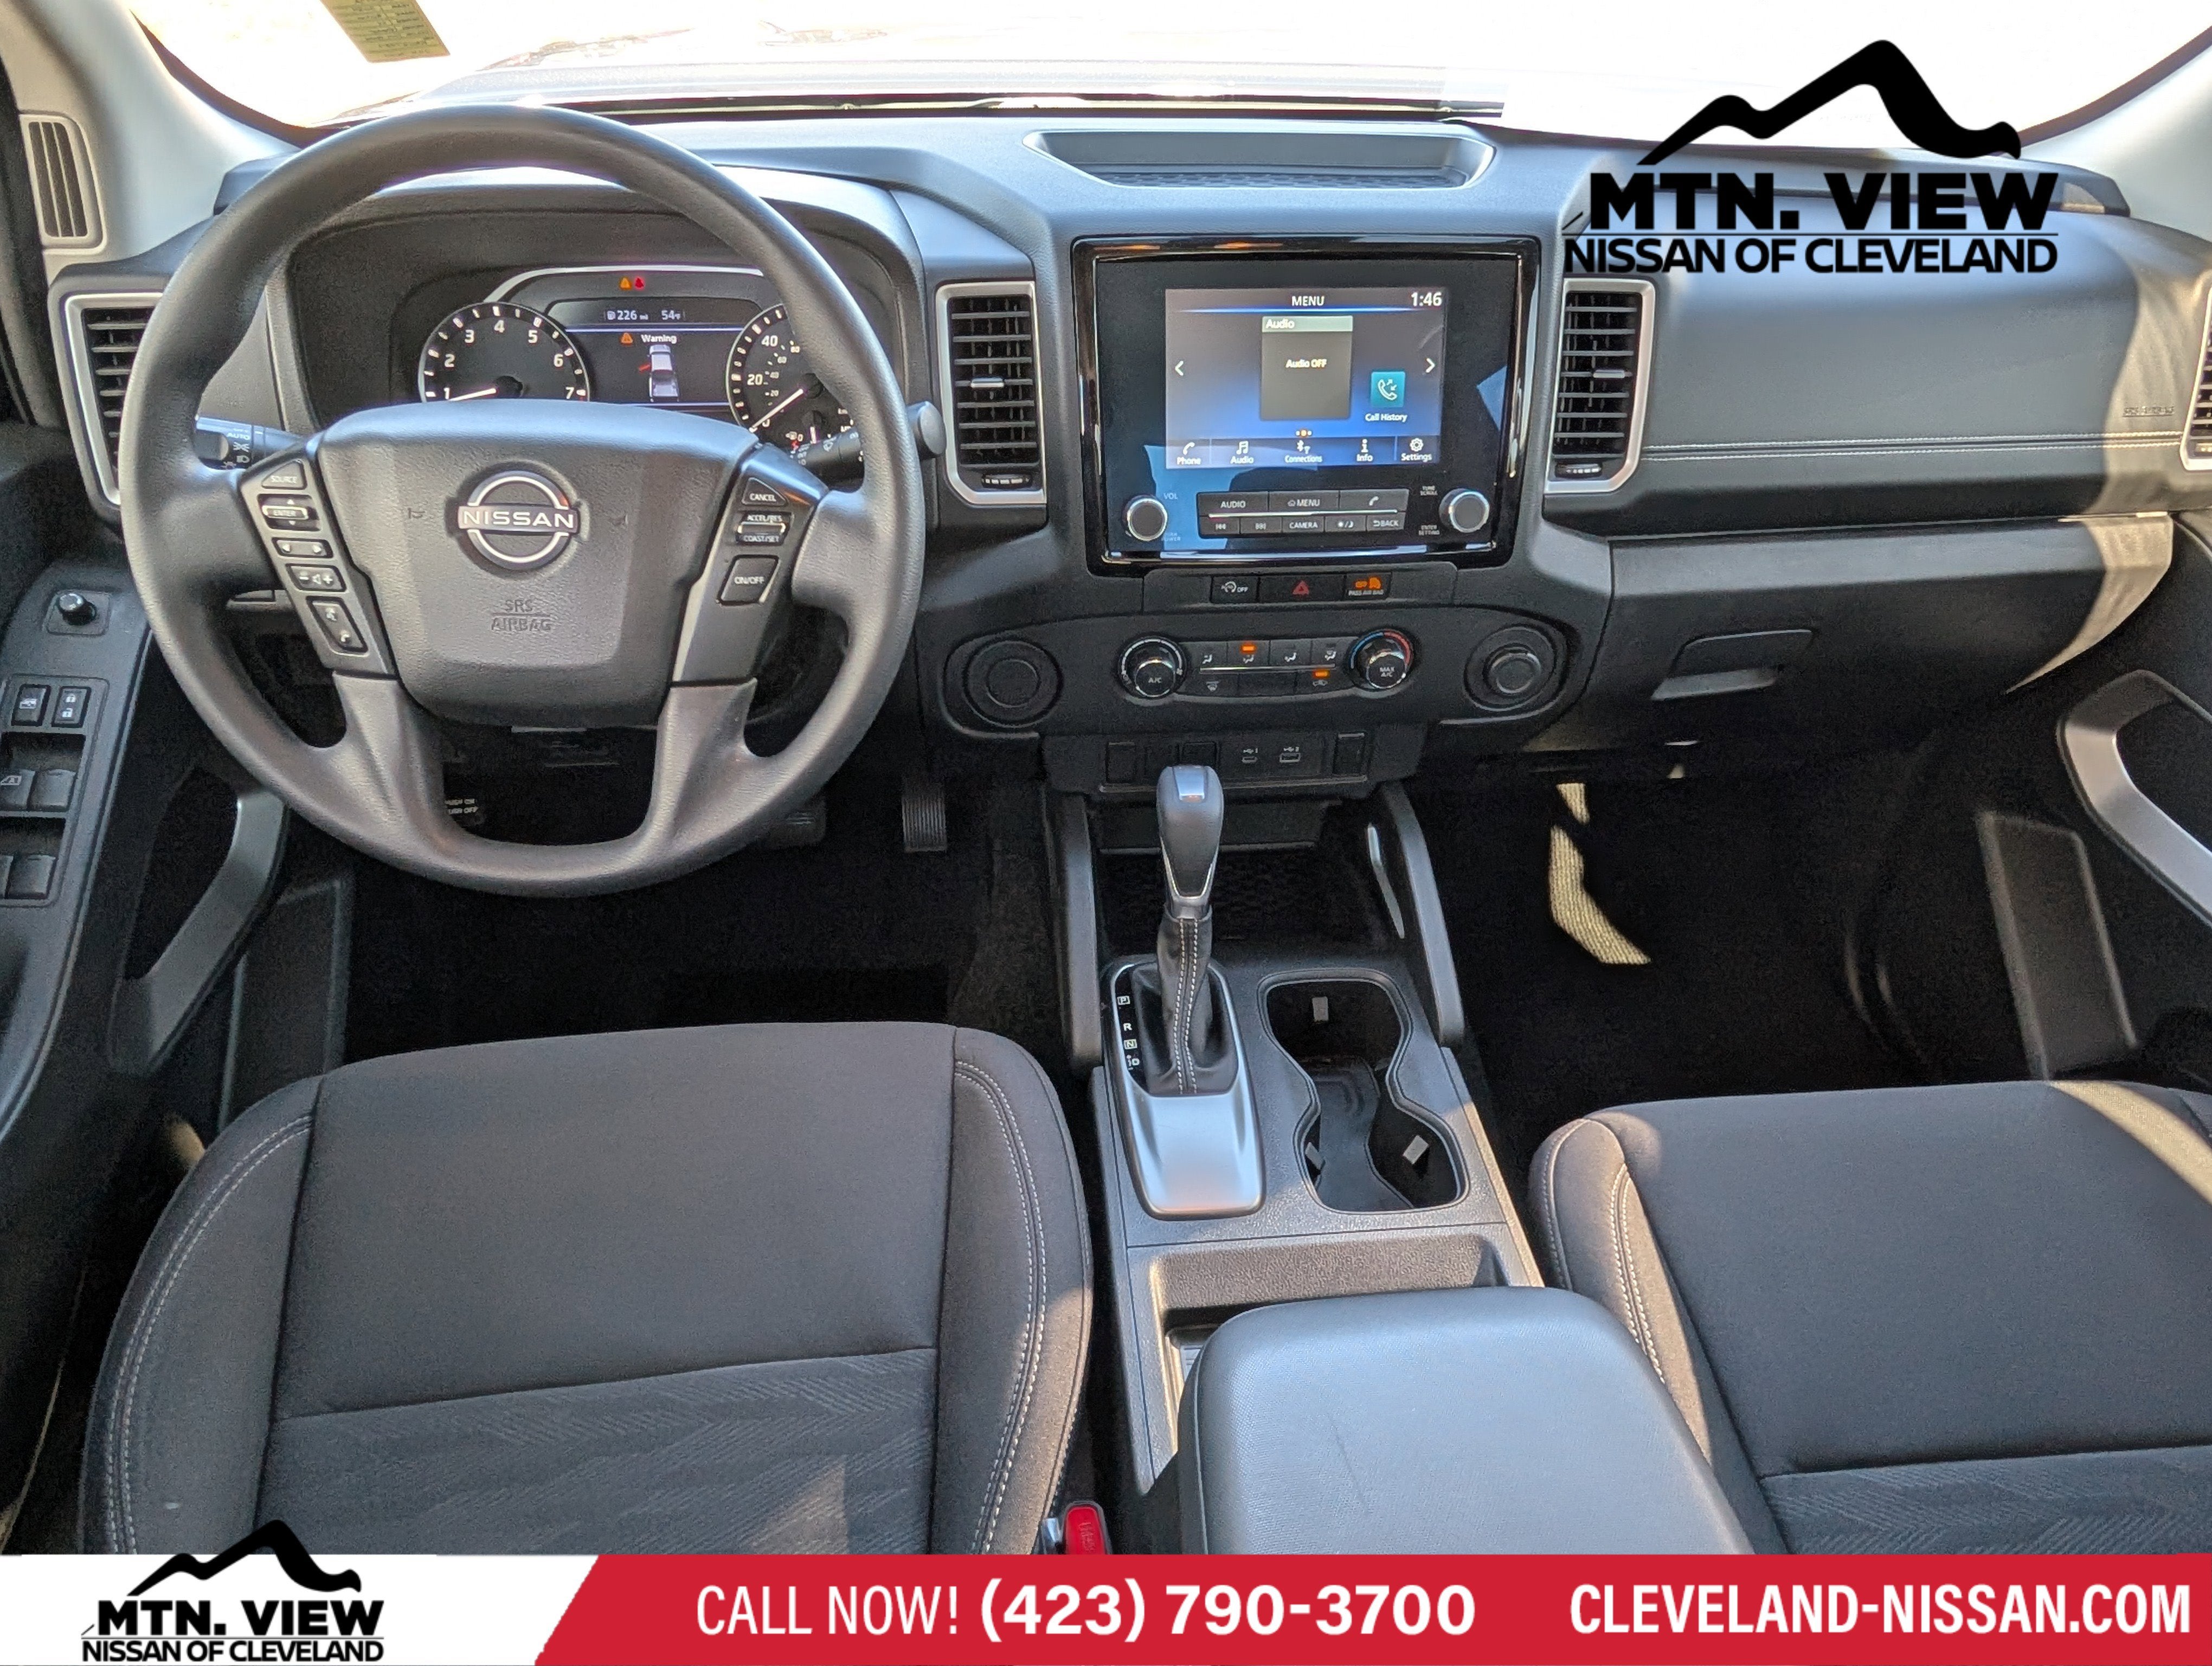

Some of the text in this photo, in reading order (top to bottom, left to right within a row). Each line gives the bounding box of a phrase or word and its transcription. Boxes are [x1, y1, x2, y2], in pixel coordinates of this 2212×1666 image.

[1291, 296, 1324, 307] MENU
[1411, 292, 1442, 307] 1:46
[617, 310, 637, 320] 226
[494, 320, 505, 333] 4
[1265, 318, 1295, 329] Audio
[465, 330, 474, 343] 3
[529, 330, 538, 343] 5
[641, 334, 677, 344] Warning
[762, 335, 777, 347] 40
[445, 354, 455, 367] 2
[554, 354, 563, 367] 6
[1286, 358, 1327, 368] Audio OFF
[747, 374, 763, 386] 20
[443, 387, 450, 399] 1
[566, 387, 574, 399] 7
[1365, 413, 1407, 422] Call History
[1176, 457, 1201, 465] Phone
[1230, 455, 1254, 465] Audio
[1285, 454, 1322, 463] Connections
[1357, 453, 1373, 462] Info
[1401, 452, 1432, 463] Settings
[272, 475, 298, 483] SOURCE
[750, 493, 776, 502] CANCEL
[464, 511, 573, 528] NISSAN
[734, 576, 764, 585] ON/OFF
[505, 599, 532, 612] SRS
[491, 617, 551, 632] AIRBAG
[1123, 1023, 1133, 1031] R
